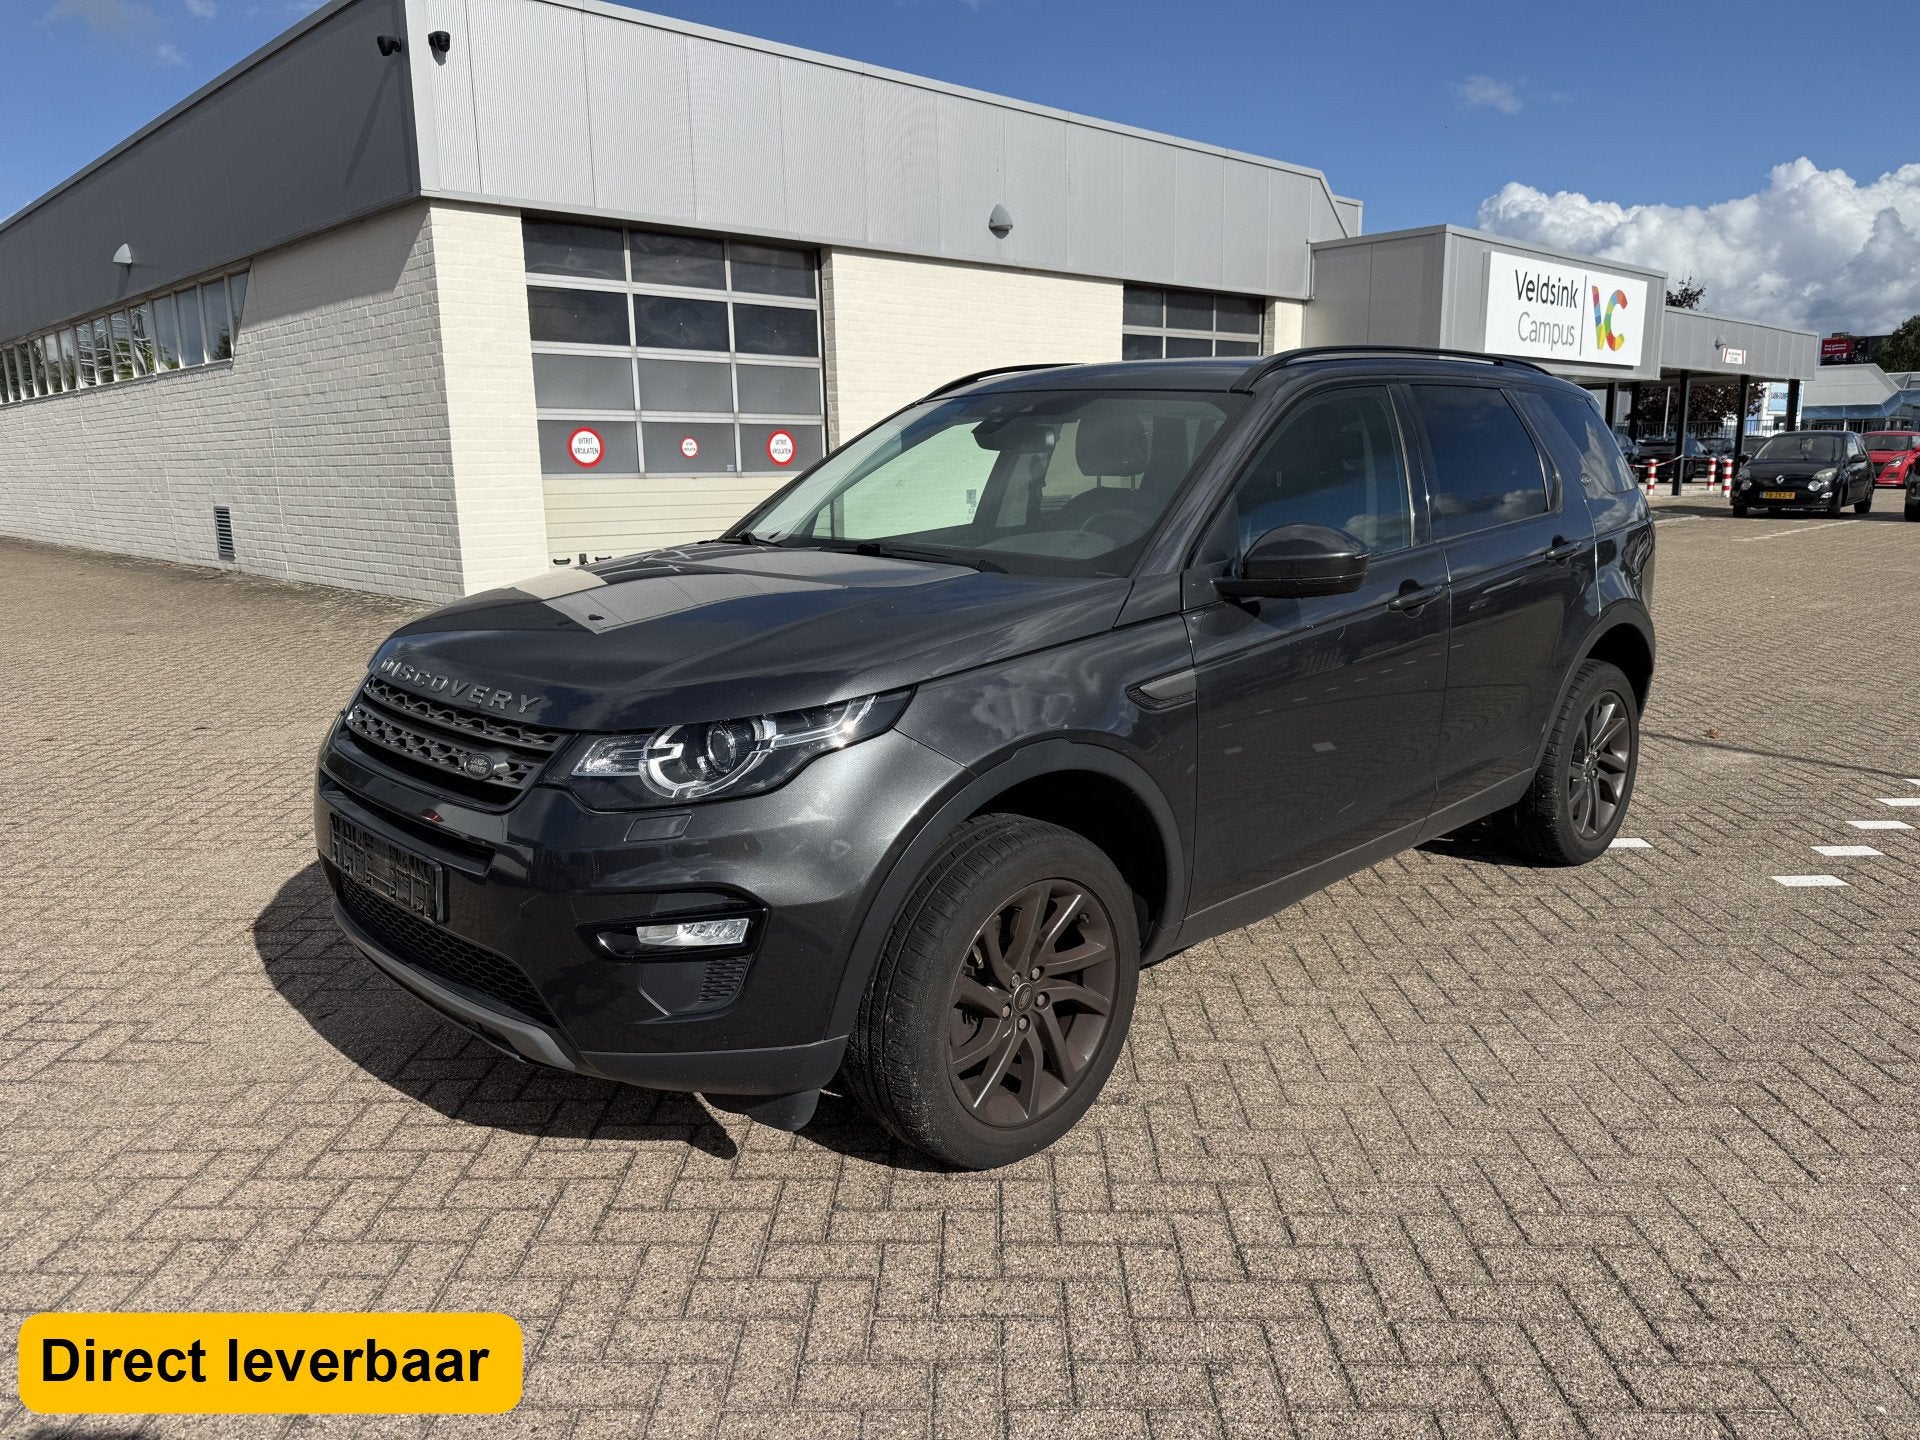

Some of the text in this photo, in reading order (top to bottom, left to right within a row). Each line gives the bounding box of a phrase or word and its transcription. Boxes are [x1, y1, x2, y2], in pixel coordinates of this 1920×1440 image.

[1515, 270, 1578, 308] Veldsink
[1518, 311, 1575, 351] Campus
[577, 437, 593, 445] UITRIT
[380, 657, 542, 714] DISCOVERY
